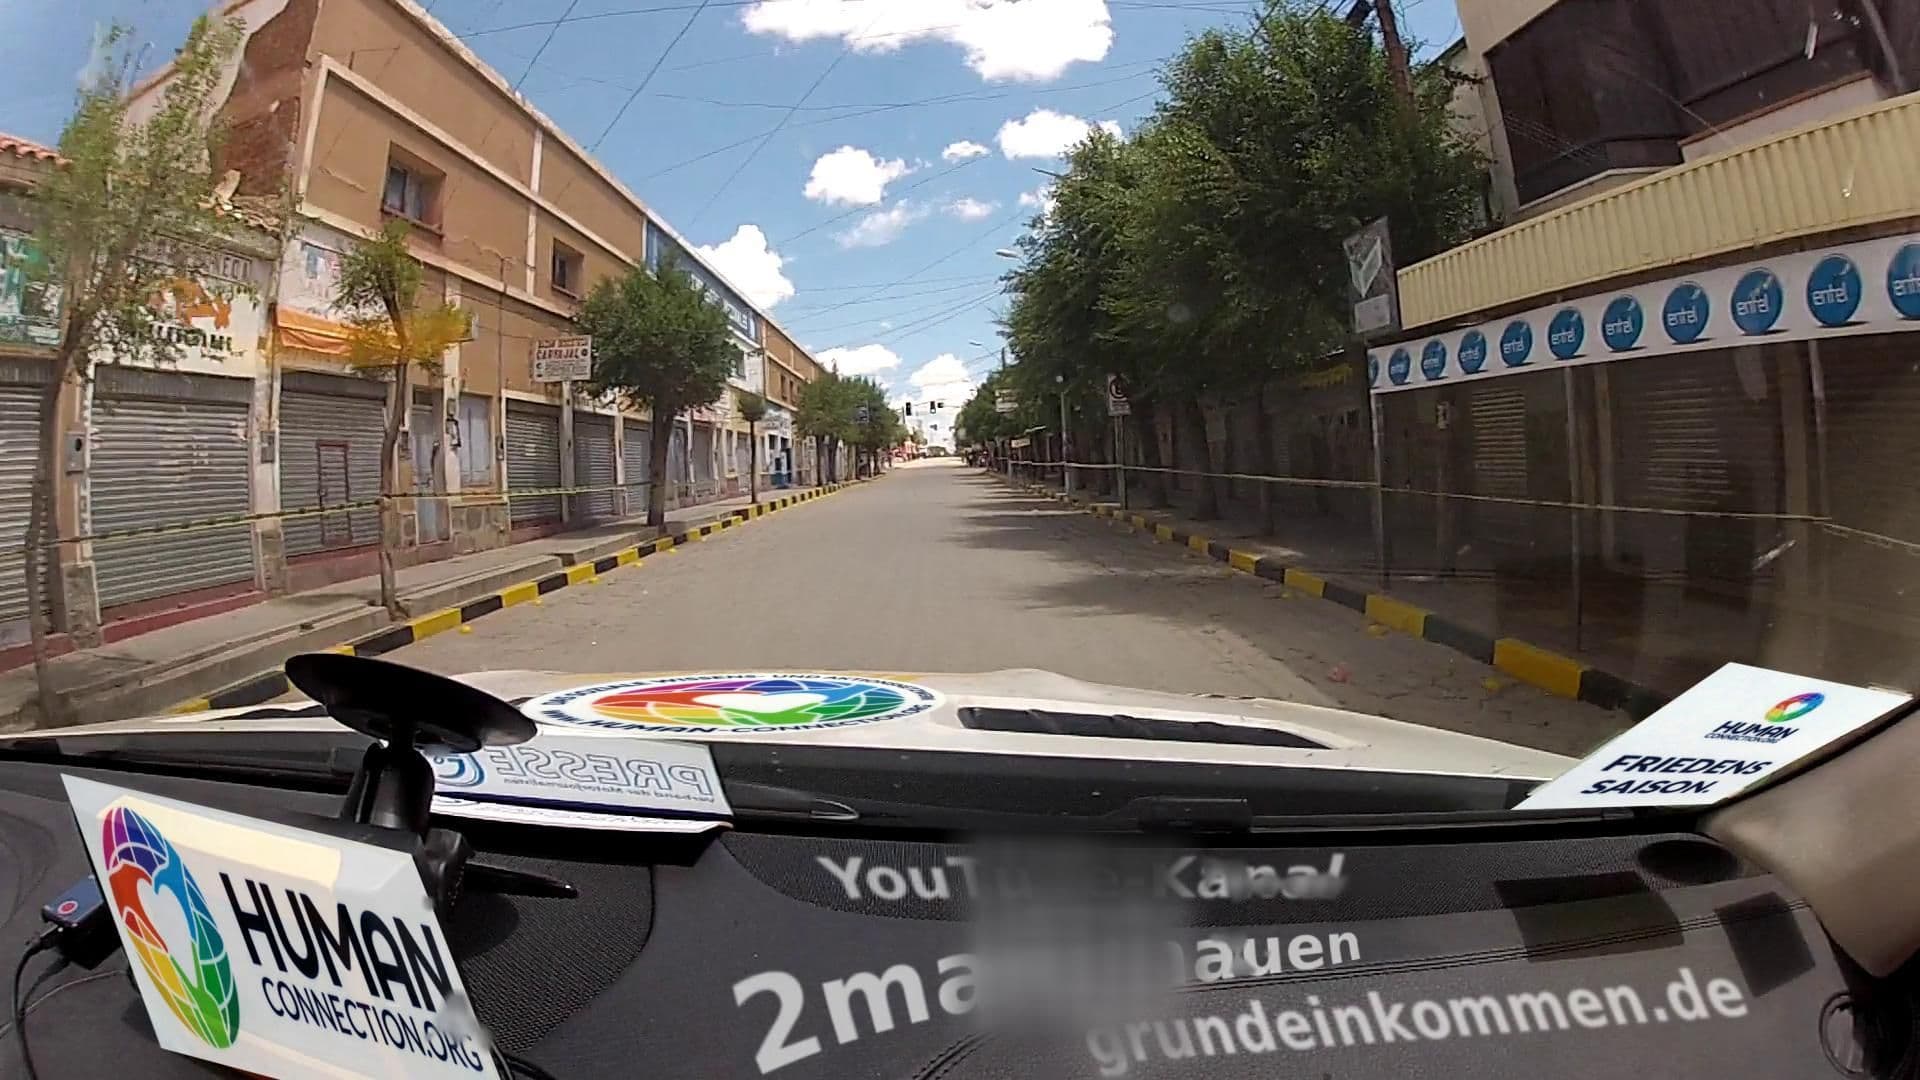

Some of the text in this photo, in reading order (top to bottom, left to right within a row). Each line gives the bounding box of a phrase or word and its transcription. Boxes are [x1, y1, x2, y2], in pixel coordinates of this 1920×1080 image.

[1713, 721, 1799, 739] HUMAN
[1601, 755, 1772, 775] FRIEDENS
[1581, 780, 1718, 794] SAISON.
[219, 872, 452, 1014] HUMAN
